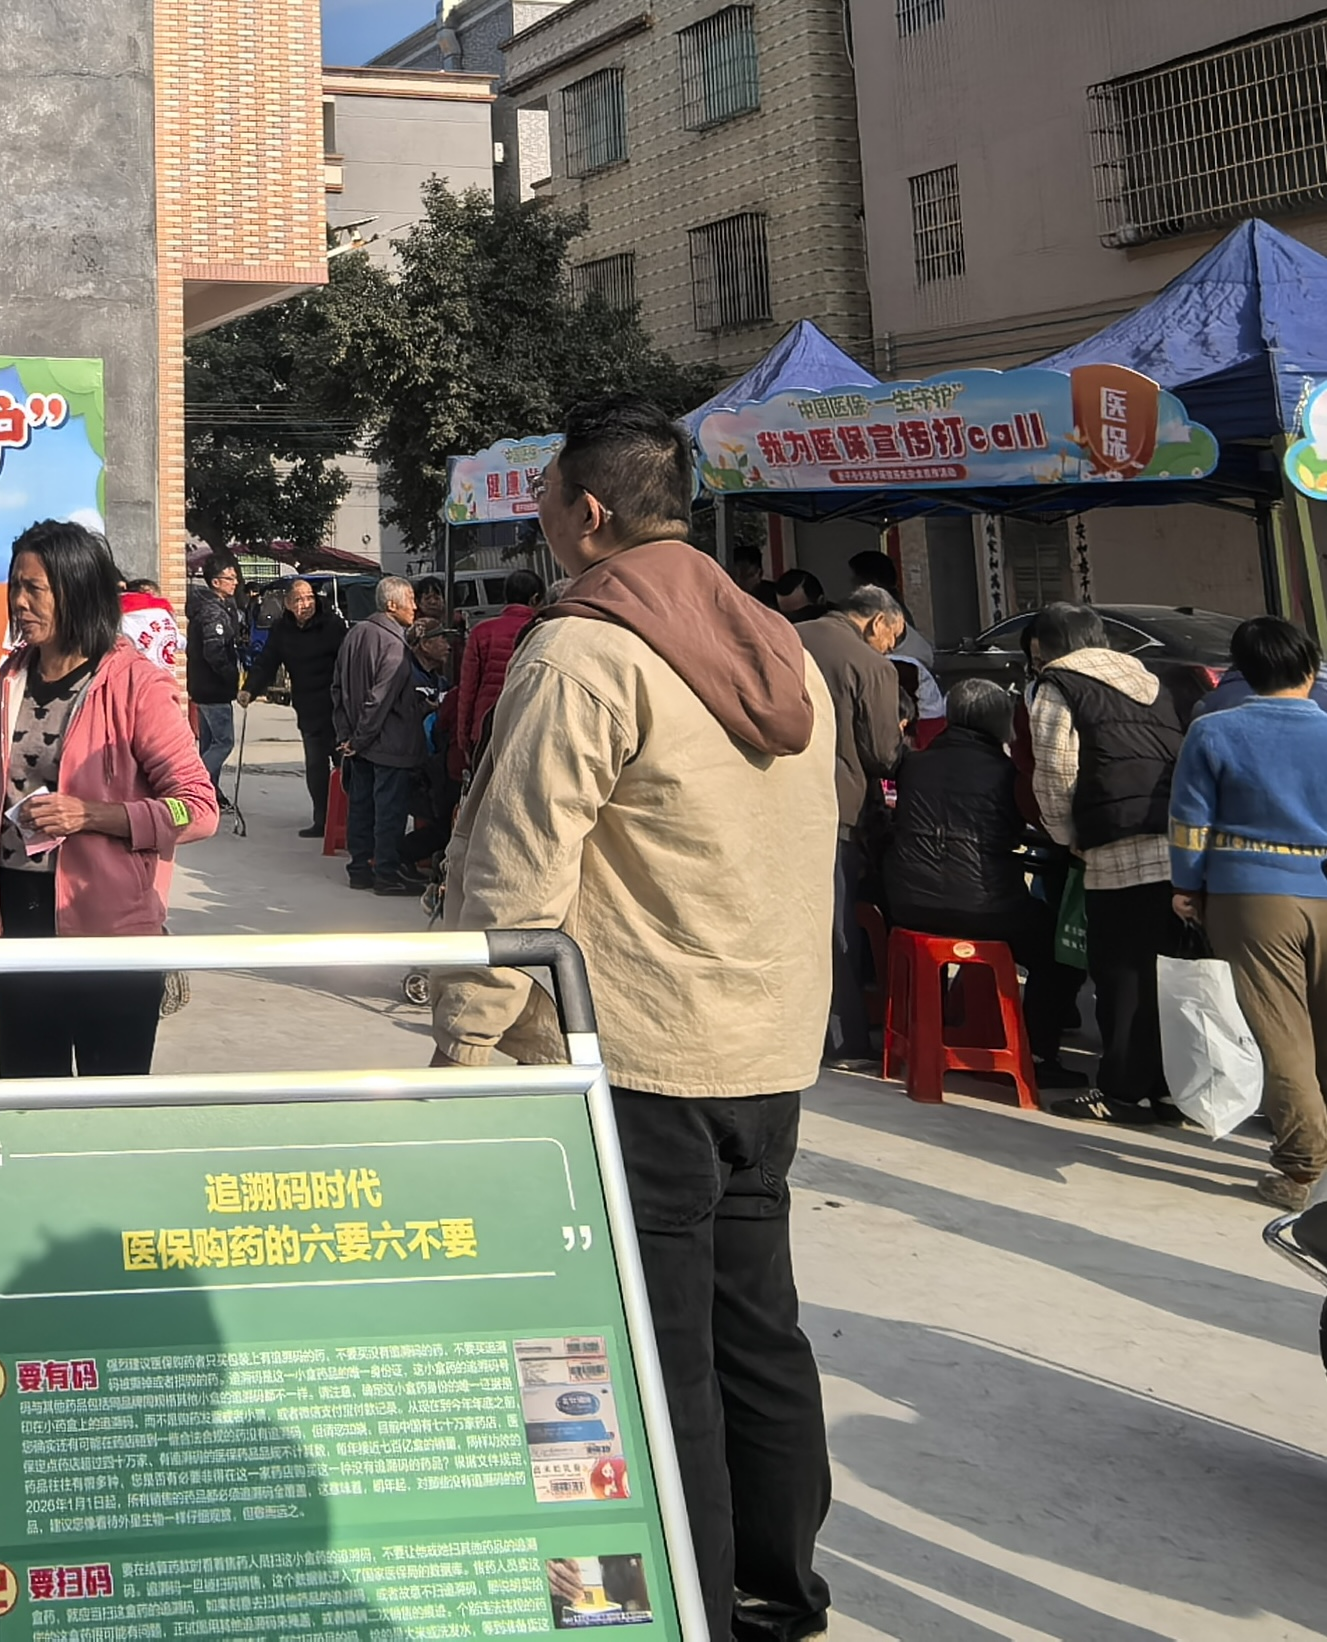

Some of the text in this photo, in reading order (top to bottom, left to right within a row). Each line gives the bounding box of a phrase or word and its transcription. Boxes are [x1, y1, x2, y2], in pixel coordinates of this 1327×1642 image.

[757, 413, 1047, 465] 我为医保宣传打call
[1100, 387, 1128, 461] 医保
[204, 1168, 382, 1216] 追溯码时代
[122, 1217, 479, 1273] 医保购药的六要六不要
[16, 1359, 99, 1393] 要有码
[28, 1563, 114, 1601] 要扫码
